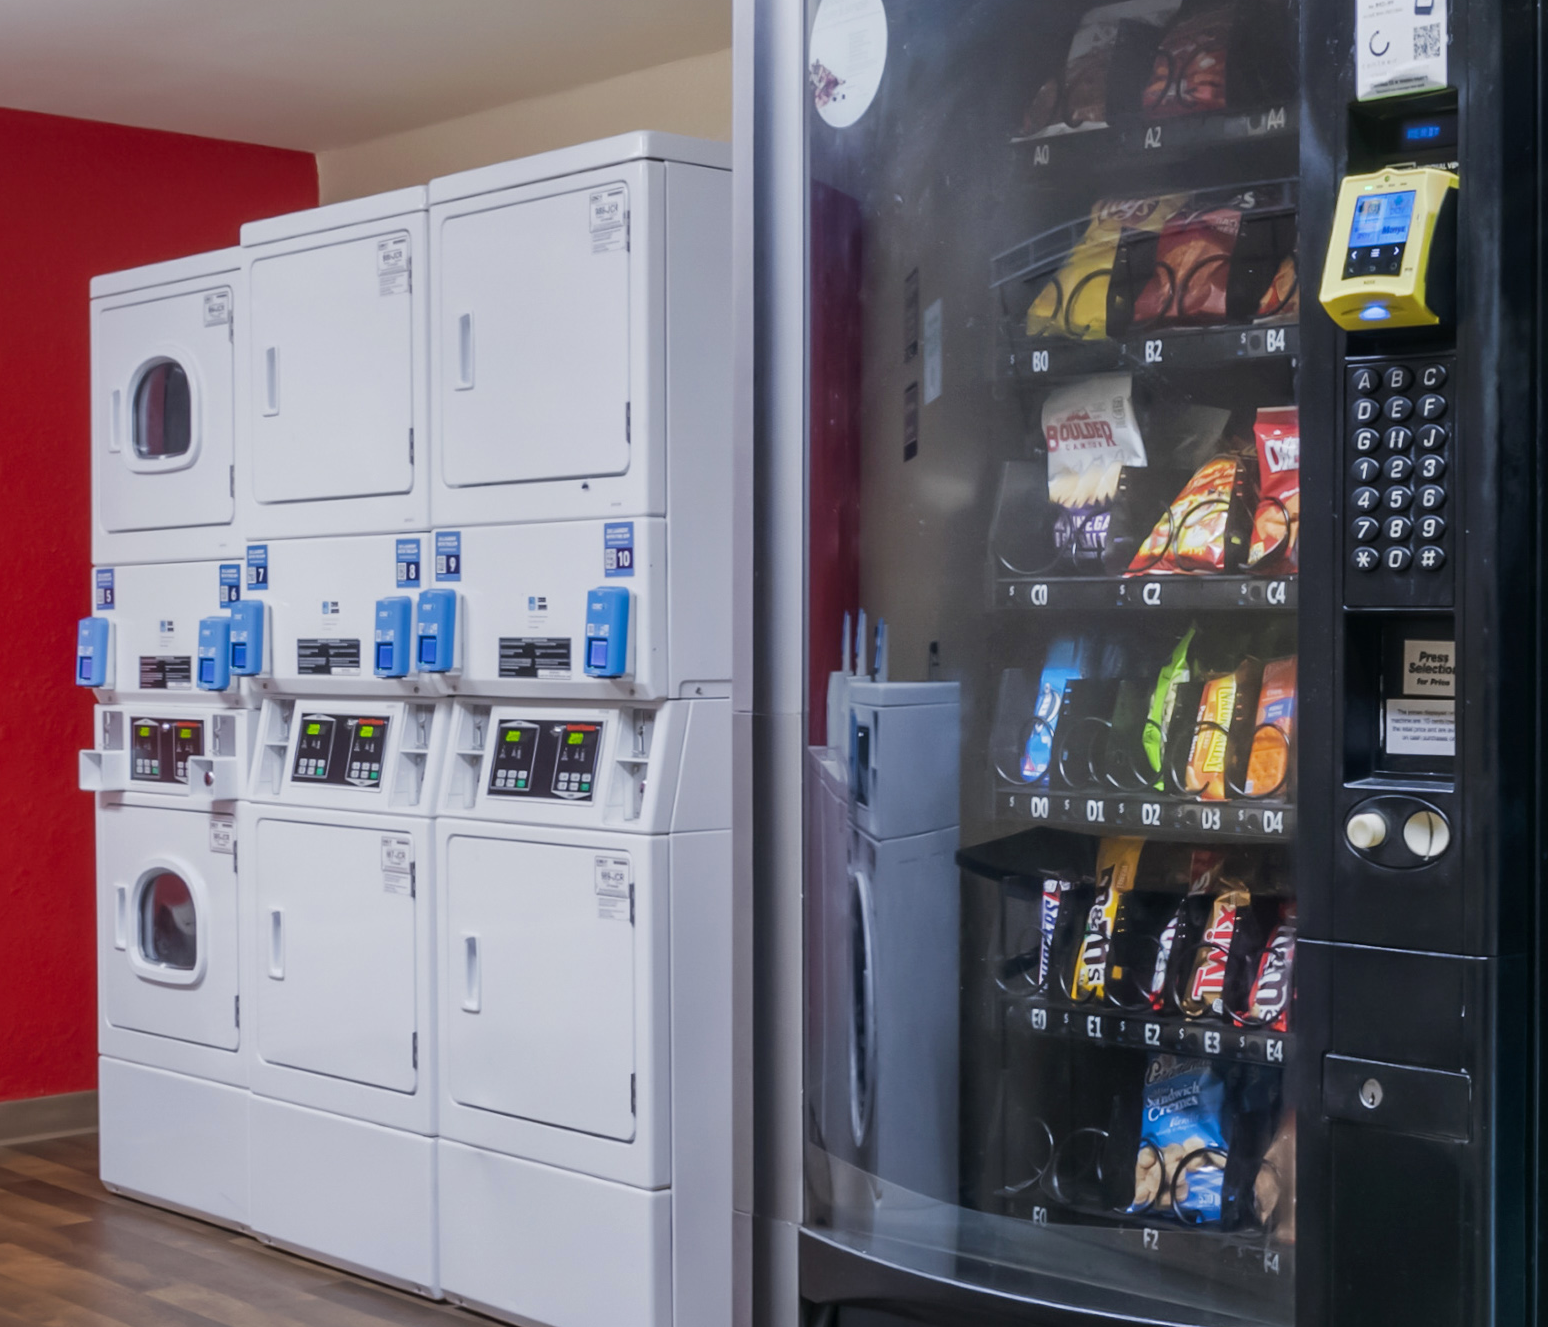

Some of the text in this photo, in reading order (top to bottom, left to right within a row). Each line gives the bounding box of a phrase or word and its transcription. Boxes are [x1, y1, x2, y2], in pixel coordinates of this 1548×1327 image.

[1145, 340, 1163, 363] B2
[1046, 420, 1116, 452] BOULDER
[449, 557, 456, 572] 9
[617, 550, 630, 566] 10
[257, 568, 264, 582] 7
[408, 564, 416, 579] 8
[106, 590, 111, 603] 5
[230, 587, 237, 601] 6
[1143, 582, 1161, 605] C2
[1142, 803, 1283, 833] D2 D4
[1204, 1021, 1221, 1054] E3
[1146, 1081, 1200, 1108] Sandwich
[1148, 1095, 1198, 1122] Cremes
